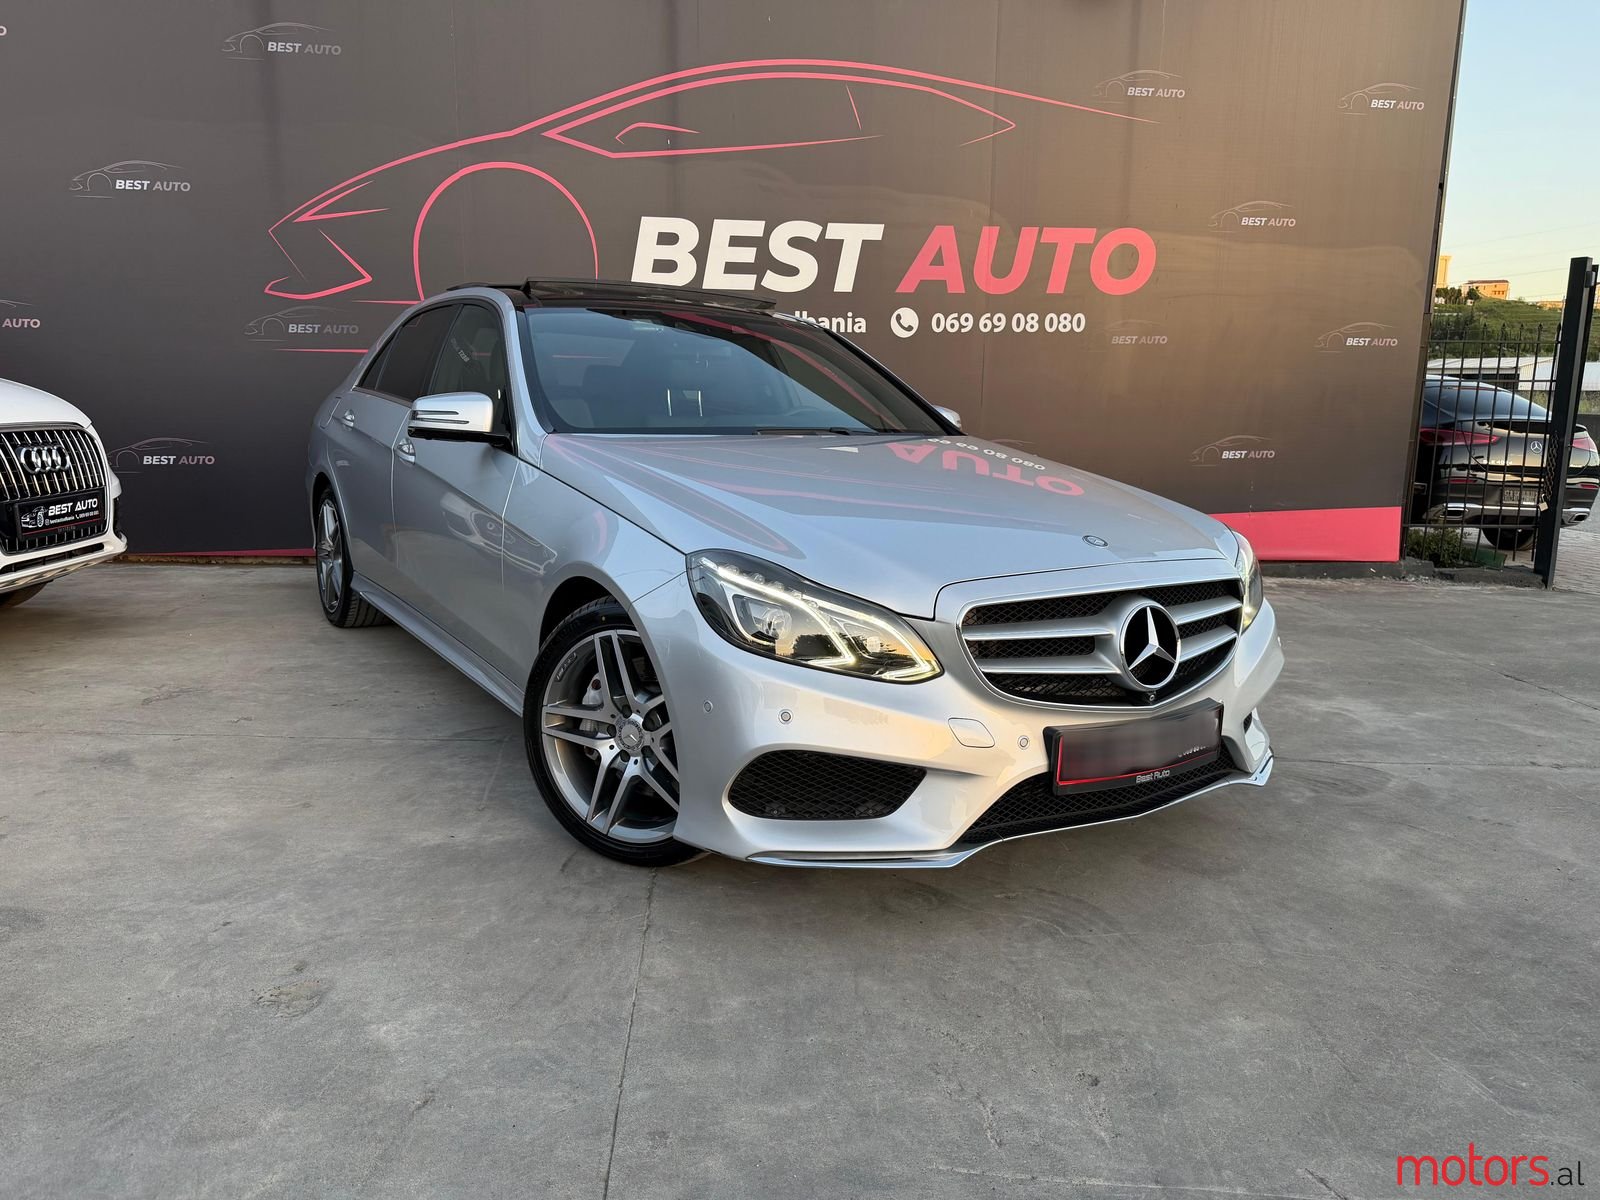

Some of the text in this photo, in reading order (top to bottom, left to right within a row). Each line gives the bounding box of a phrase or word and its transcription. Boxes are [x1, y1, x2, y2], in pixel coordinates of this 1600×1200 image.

[267, 41, 341, 55] BEST AUTO
[1127, 86, 1185, 98] BEST AUTO
[1370, 99, 1425, 110] BEST AUTO
[115, 179, 191, 192] BEST AUTO
[1240, 216, 1296, 227] BEST AUTO
[630, 216, 1157, 295] BEST AUTO
[2, 318, 41, 328] AUTO
[288, 322, 359, 334] BEST AUTO
[931, 312, 974, 333] 069
[978, 312, 1006, 333] 69
[1011, 313, 1039, 333] 08
[1044, 313, 1086, 333] 080
[1111, 335, 1168, 345] BEST AUTO
[1345, 337, 1398, 347] BEST AUTO
[1221, 449, 1275, 459] BEST AUTO
[143, 455, 215, 466] BEST AUTO
[48, 503, 74, 516] BEST
[75, 498, 98, 512] AUTO
